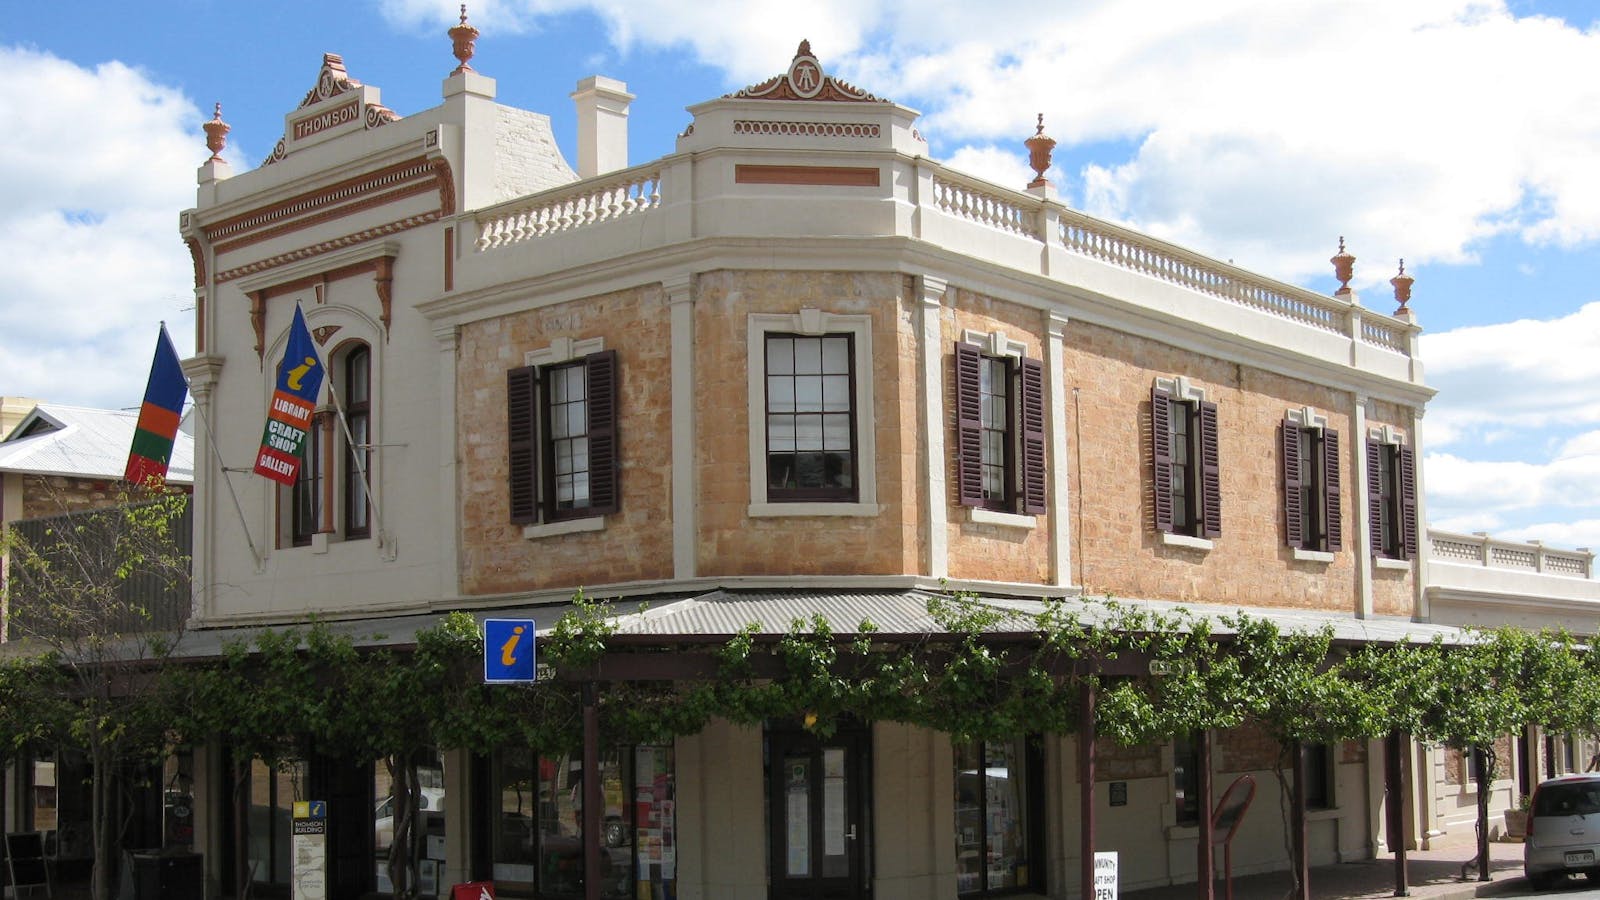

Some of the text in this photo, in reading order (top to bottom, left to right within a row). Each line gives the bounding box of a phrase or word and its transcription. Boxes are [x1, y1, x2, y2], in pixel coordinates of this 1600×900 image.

[296, 104, 358, 136] THOMSON
[274, 398, 311, 421] LIBRARY
[268, 420, 306, 442] CRAFT
[269, 435, 297, 454] SHOP
[260, 454, 294, 477] GALLERY
[1098, 888, 1113, 900] PEN
